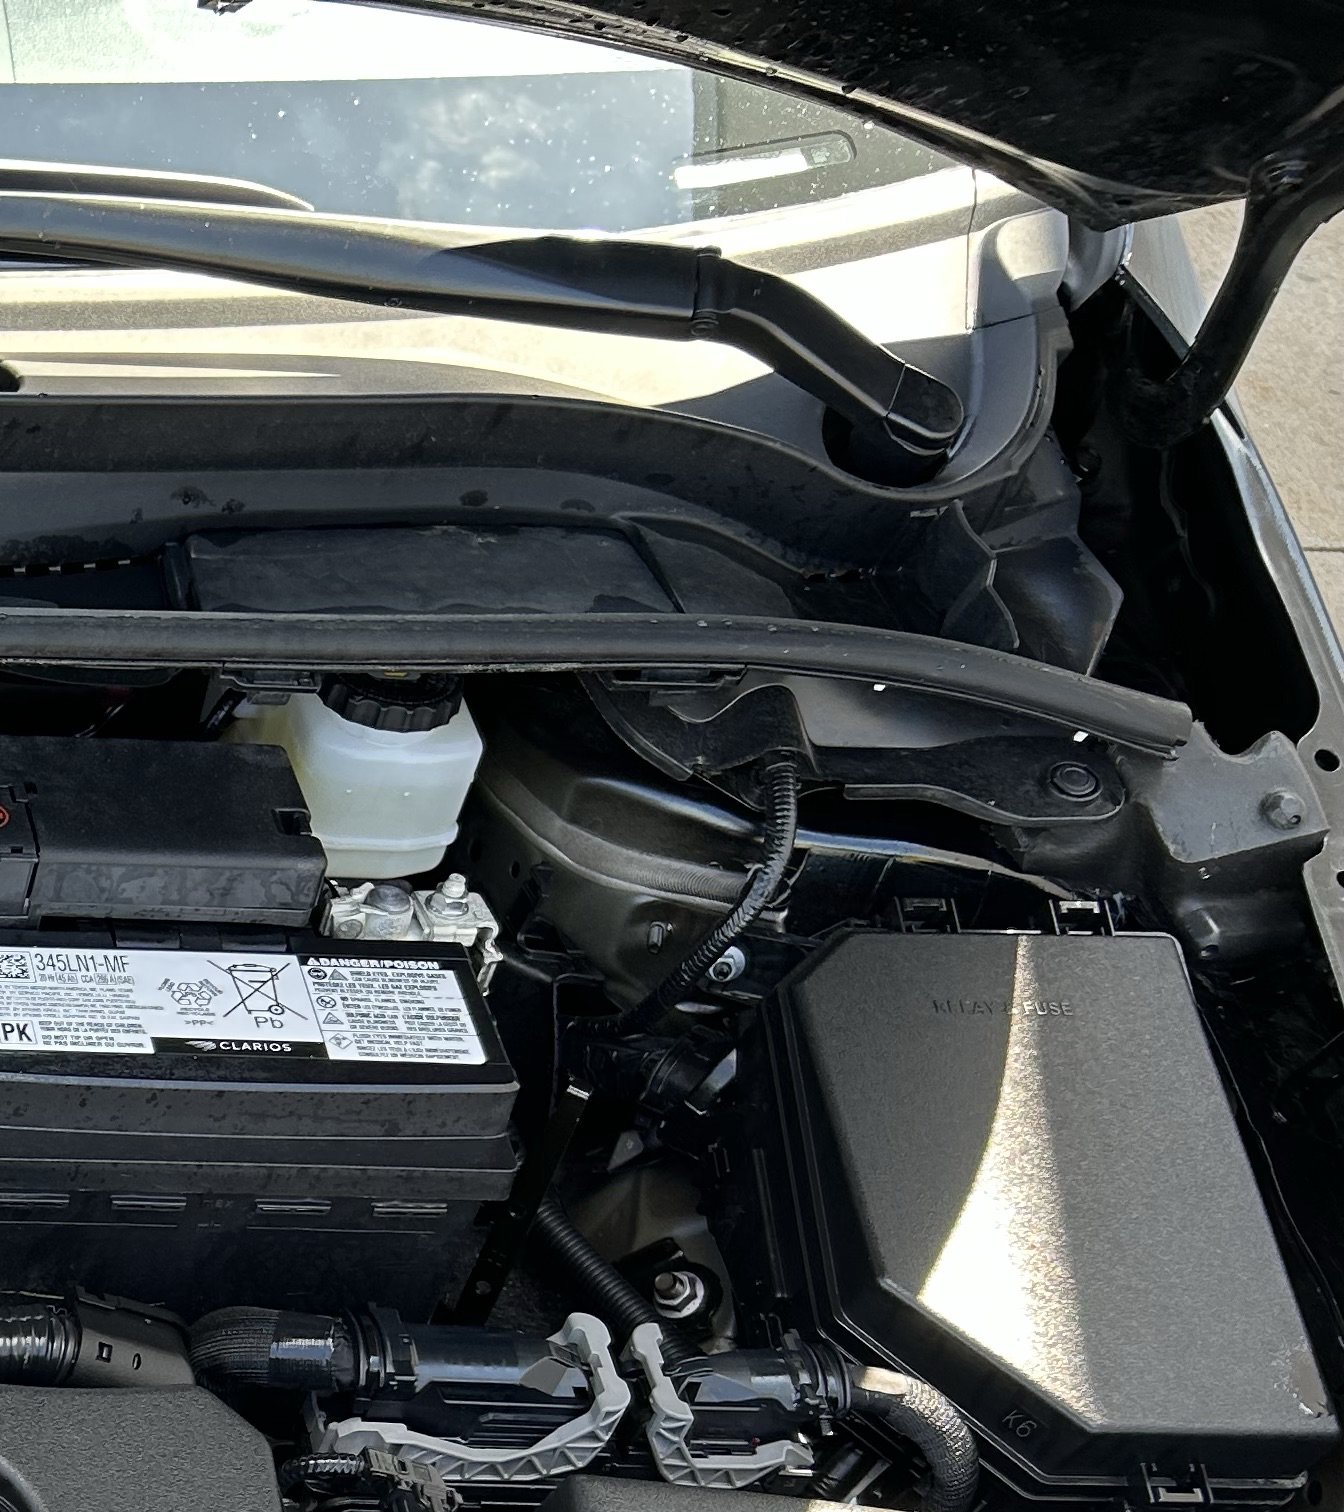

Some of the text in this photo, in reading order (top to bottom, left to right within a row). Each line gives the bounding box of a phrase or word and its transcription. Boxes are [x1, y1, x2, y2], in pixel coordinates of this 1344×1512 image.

[35, 953, 130, 972] 345LN1-MF
[319, 958, 439, 970] DANGER/POISON
[1023, 1000, 1074, 1016] FUSE
[254, 1016, 283, 1029] Pb
[1, 1023, 32, 1042] PK
[219, 1041, 292, 1052] CLARIOS
[1002, 1410, 1037, 1437] K6
